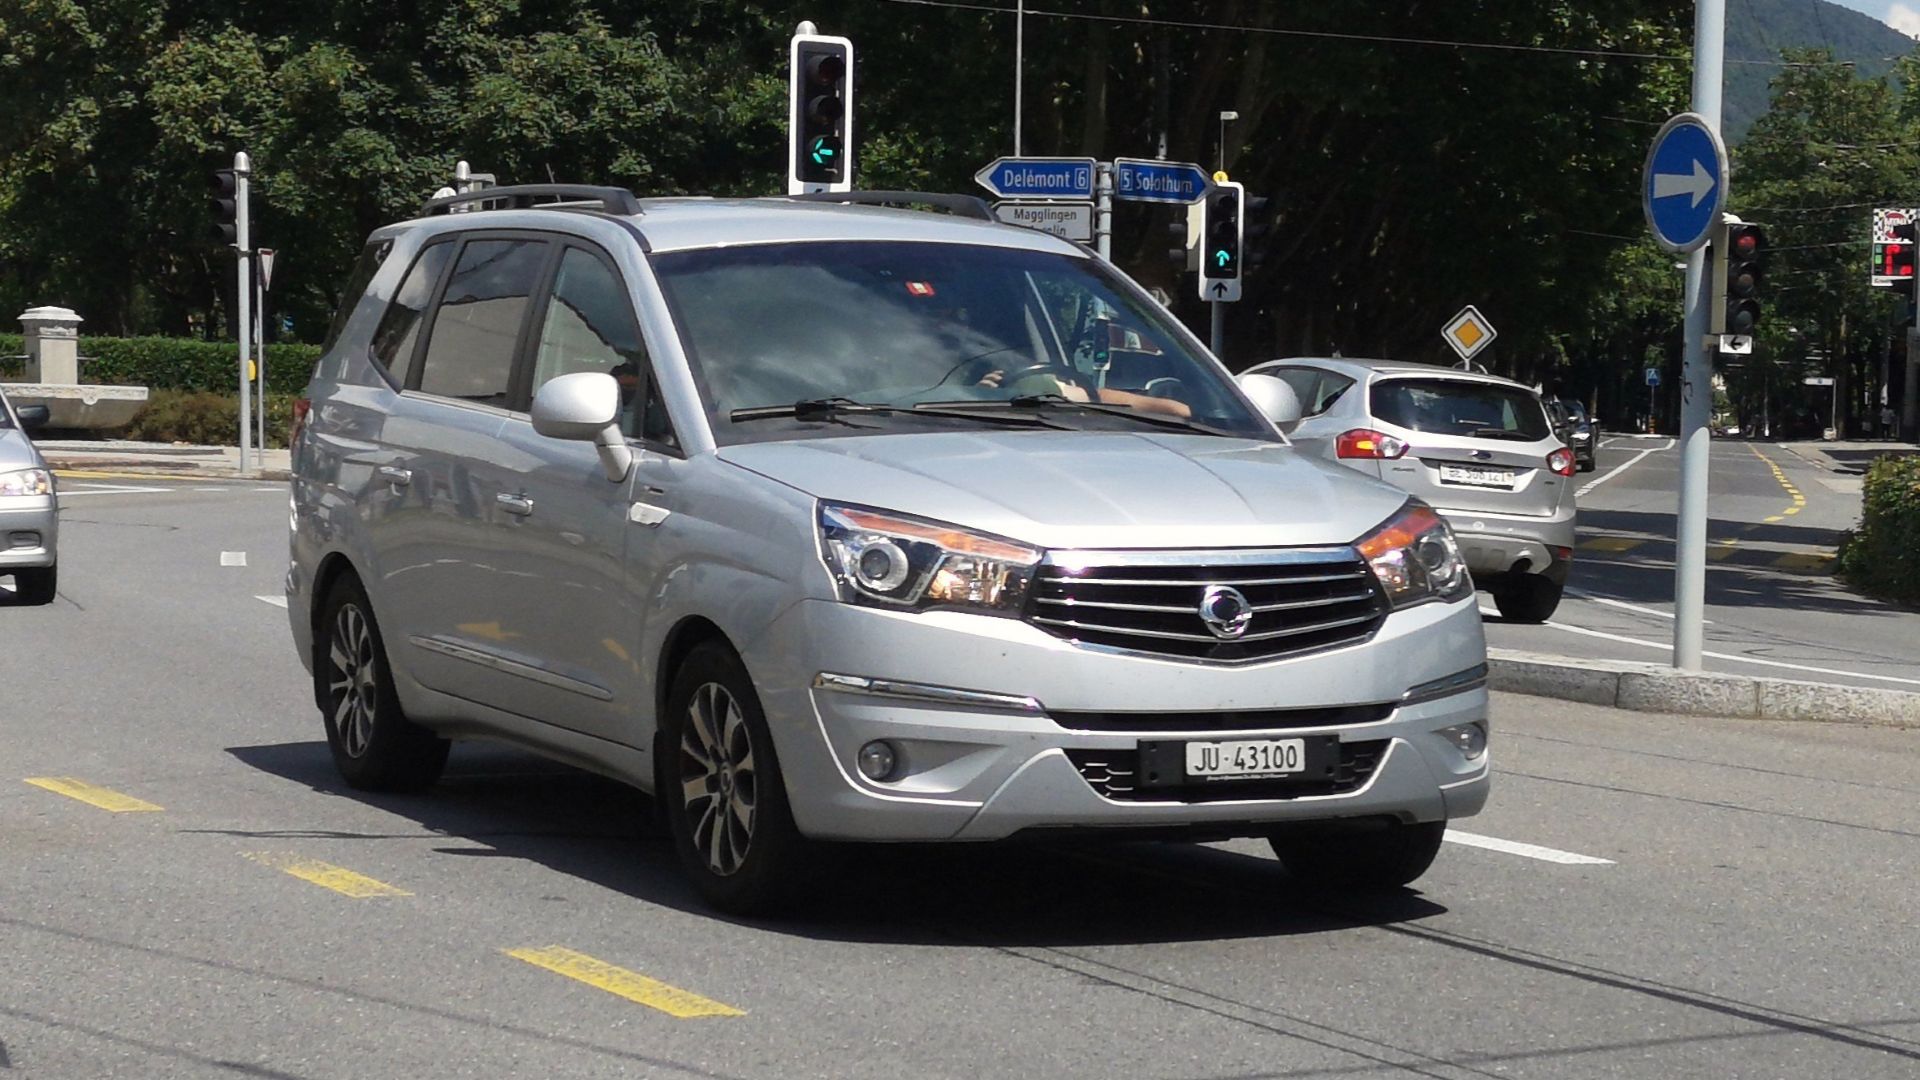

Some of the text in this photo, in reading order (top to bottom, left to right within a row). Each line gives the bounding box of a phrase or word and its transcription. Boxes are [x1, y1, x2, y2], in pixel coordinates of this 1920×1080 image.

[1004, 168, 1086, 188] Delémont 6
[1122, 171, 1193, 193] 5 Solothurn
[1014, 208, 1077, 223] Magglingen
